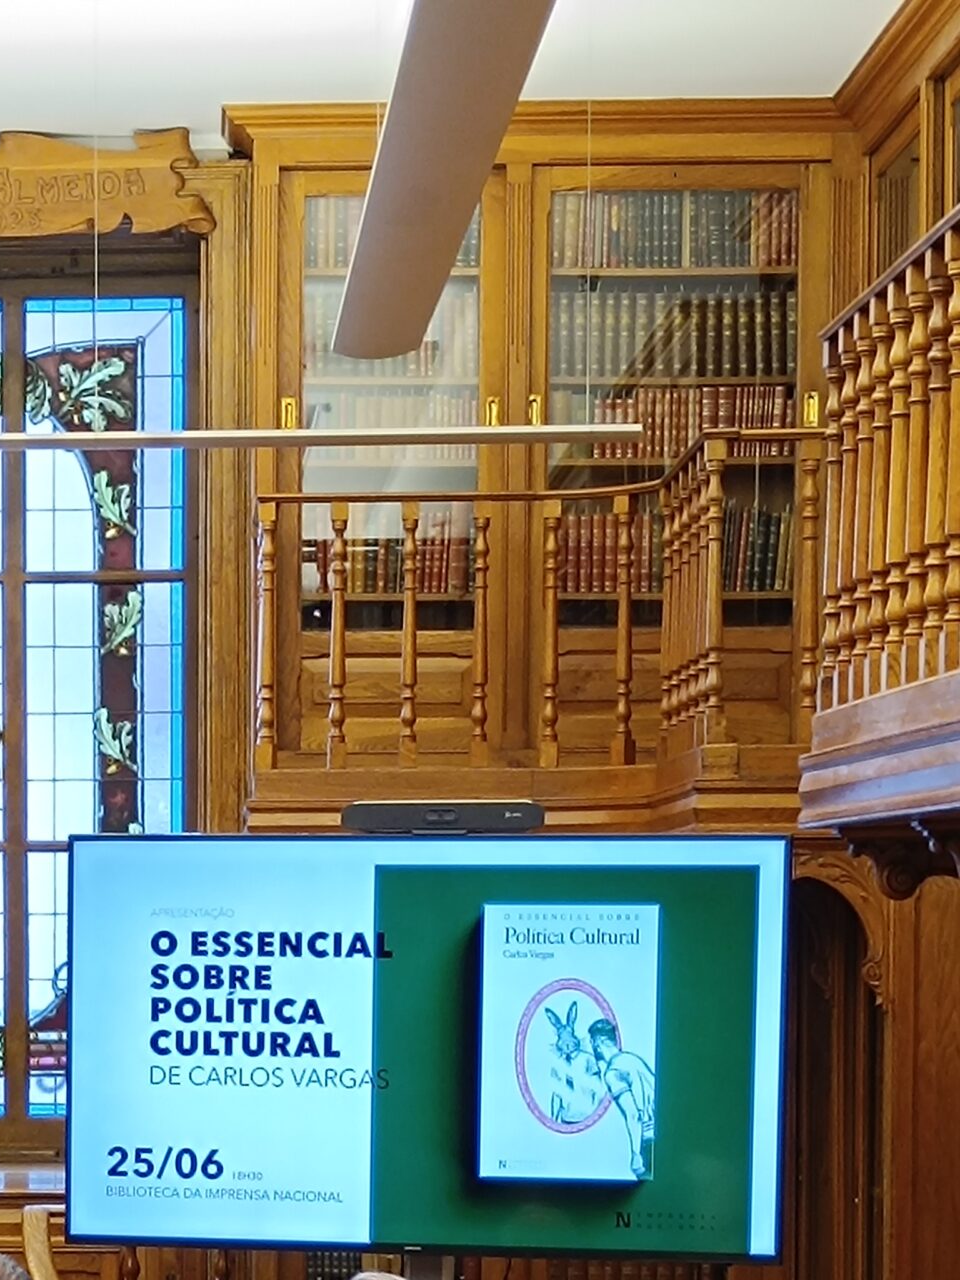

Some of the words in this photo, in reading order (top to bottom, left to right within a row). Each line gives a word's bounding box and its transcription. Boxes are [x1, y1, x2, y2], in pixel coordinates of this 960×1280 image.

[150, 907, 235, 920] APRESENTAÇÃO
[150, 930, 178, 956] O
[191, 931, 394, 959] ESSENCIAL
[504, 926, 565, 945] Política
[570, 927, 640, 945] Cultural
[150, 963, 272, 990] SOBRE
[151, 991, 325, 1025] POLÍTICA
[150, 1029, 341, 1058] CULTURAL
[150, 1065, 181, 1086] DE
[189, 1066, 284, 1087] CARLOS
[290, 1068, 390, 1090] VARGAS
[107, 1146, 224, 1180] 25/06
[106, 1185, 180, 1199] BIBLIOTECA
[183, 1187, 202, 1200] DA
[205, 1188, 271, 1201] IMPRENSA
[273, 1190, 343, 1204] NACIONAL
